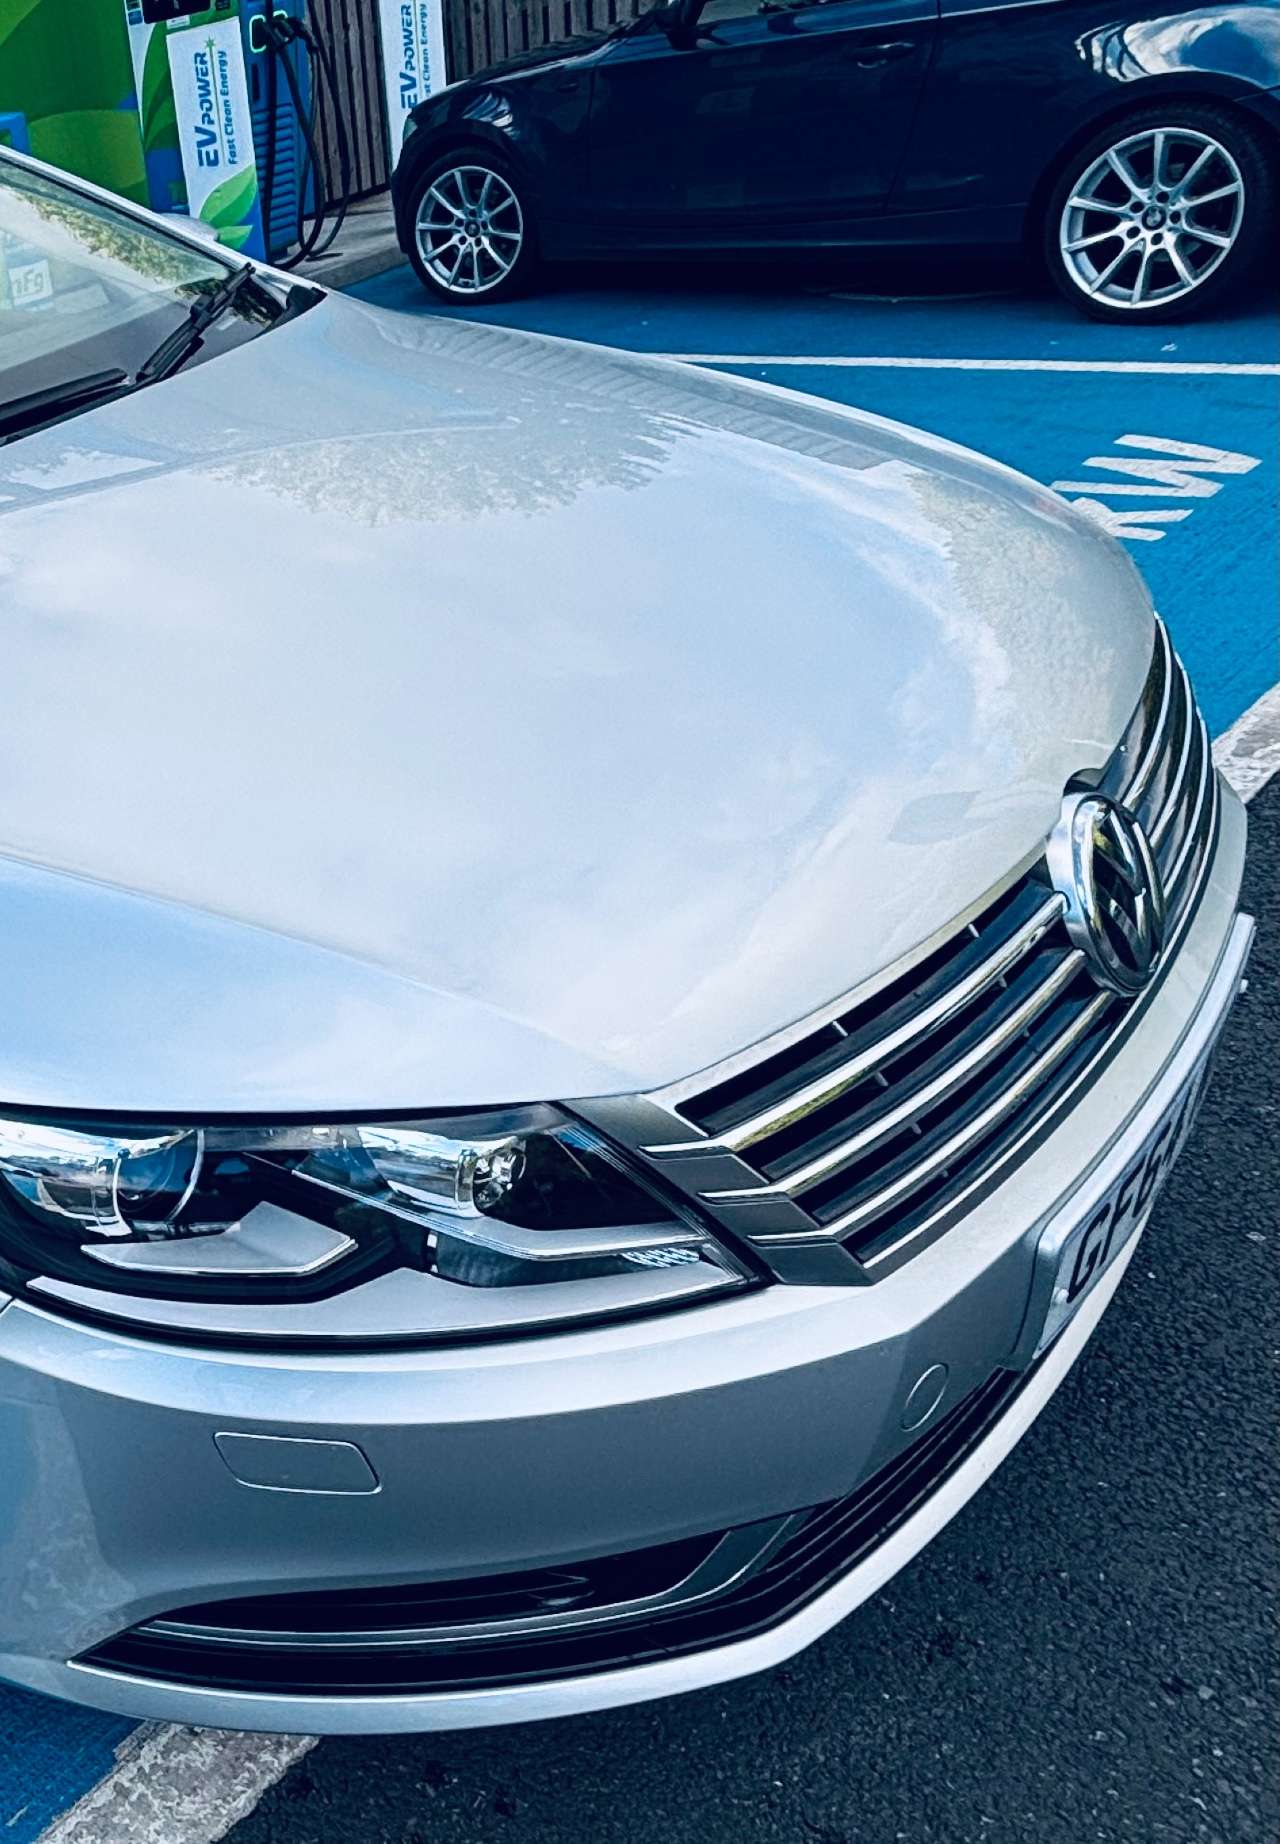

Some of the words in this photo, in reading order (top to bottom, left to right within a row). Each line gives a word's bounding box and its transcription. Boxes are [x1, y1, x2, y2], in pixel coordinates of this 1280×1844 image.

[419, 3, 428, 45] Energy
[218, 50, 229, 97] Energy
[422, 48, 431, 81] Clean
[194, 52, 216, 125] POWER
[223, 99, 234, 136] Clean
[227, 139, 239, 165] Fast
